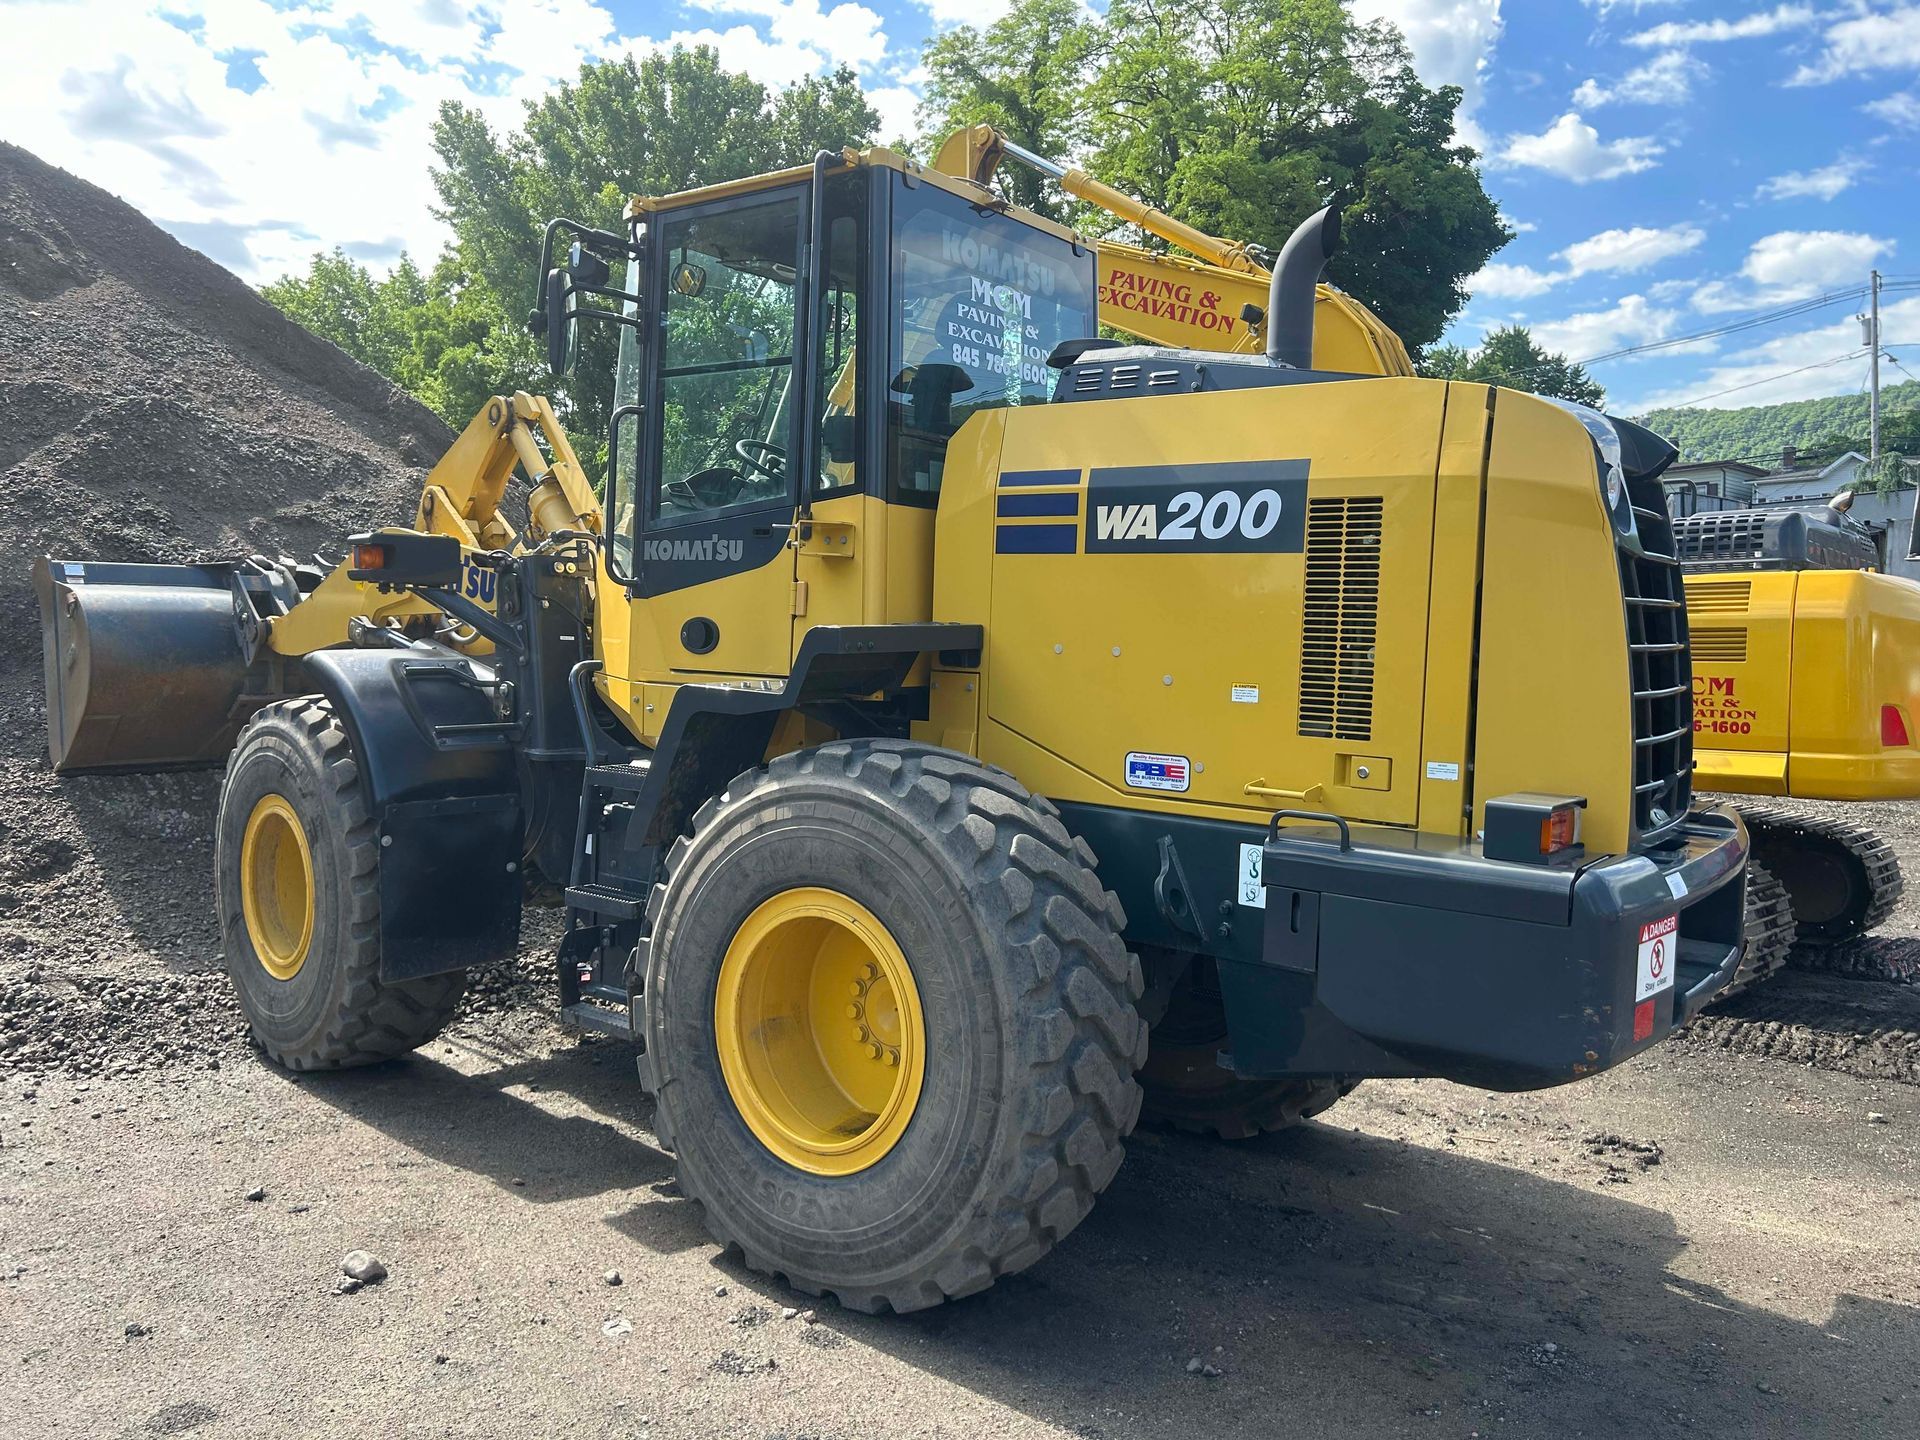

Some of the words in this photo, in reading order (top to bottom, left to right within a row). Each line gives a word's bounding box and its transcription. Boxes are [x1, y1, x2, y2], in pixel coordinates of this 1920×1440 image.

[943, 229, 1055, 296] KOMATSU
[970, 275, 1032, 320] MCM
[1108, 270, 1193, 304] PAVING
[1199, 291, 1221, 310] &
[957, 303, 1022, 332] PAVING
[1025, 325, 1039, 340] &
[1098, 285, 1236, 334] EXCAVATION
[948, 321, 1051, 362] EXCAVATION
[952, 343, 980, 368] 845
[1097, 488, 1283, 541] WA200
[643, 533, 744, 562] KOMATSU
[1692, 676, 1736, 696] CM
[1694, 708, 1757, 720] ATION
[1722, 698, 1740, 708] &
[1693, 719, 1751, 735] 6-1600
[1130, 761, 1185, 779] PBE
[1649, 916, 1676, 938] DANGER
[1645, 981, 1656, 992] Stay
[1656, 975, 1668, 987] clear
